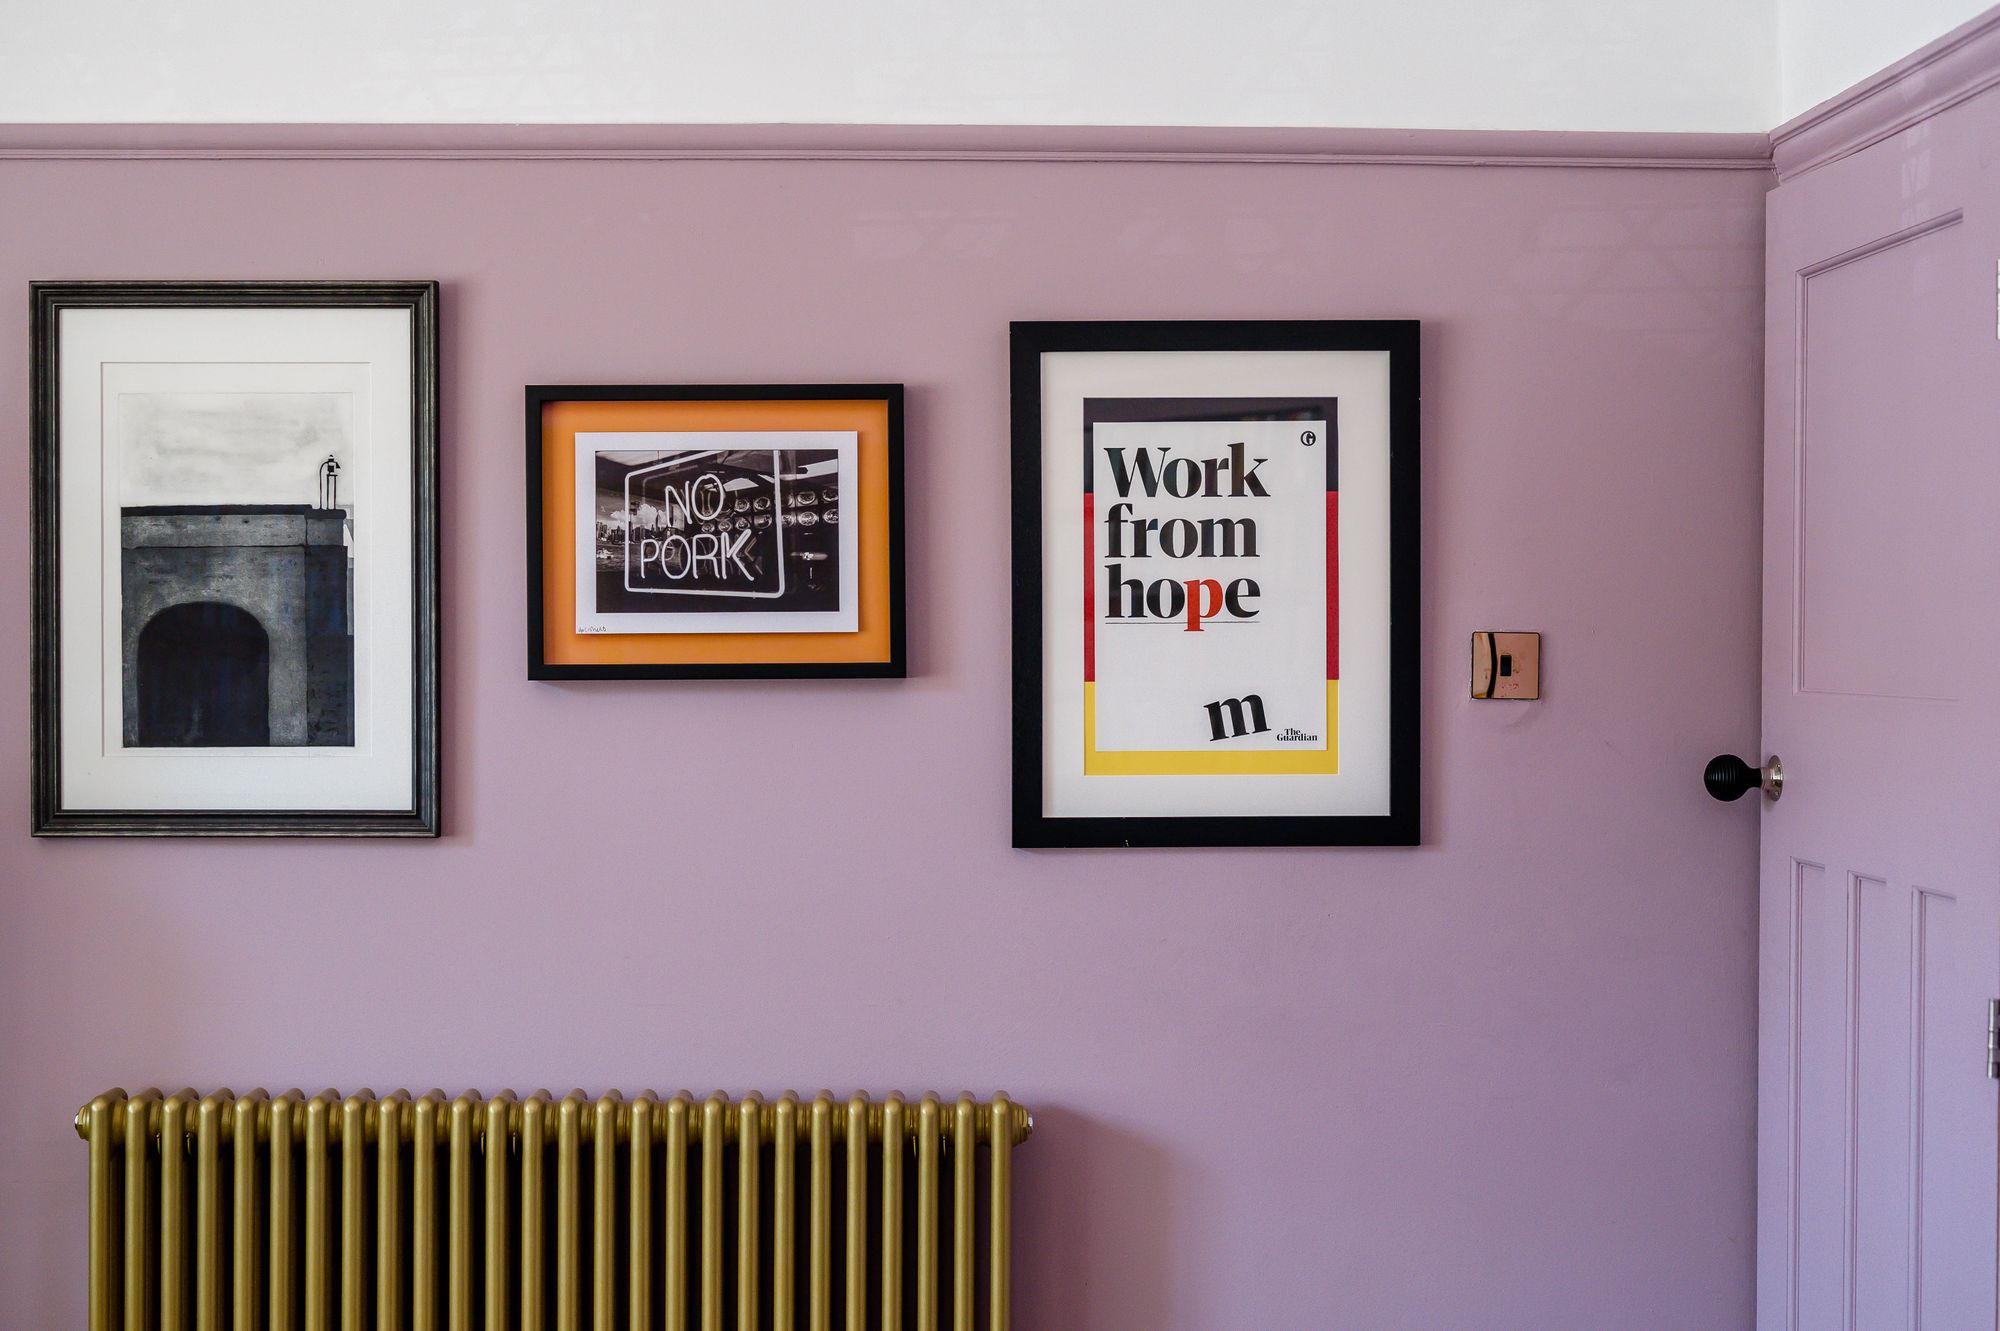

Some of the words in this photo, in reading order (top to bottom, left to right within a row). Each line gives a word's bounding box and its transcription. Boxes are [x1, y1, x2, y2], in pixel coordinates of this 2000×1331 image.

[1103, 442, 1271, 498] Work
[665, 473, 724, 528] NO
[641, 529, 755, 581] PORK
[1104, 503, 1260, 558] from
[1104, 563, 1261, 632] hope
[1203, 694, 1271, 742] m
[1276, 733, 1318, 741] Guardian
